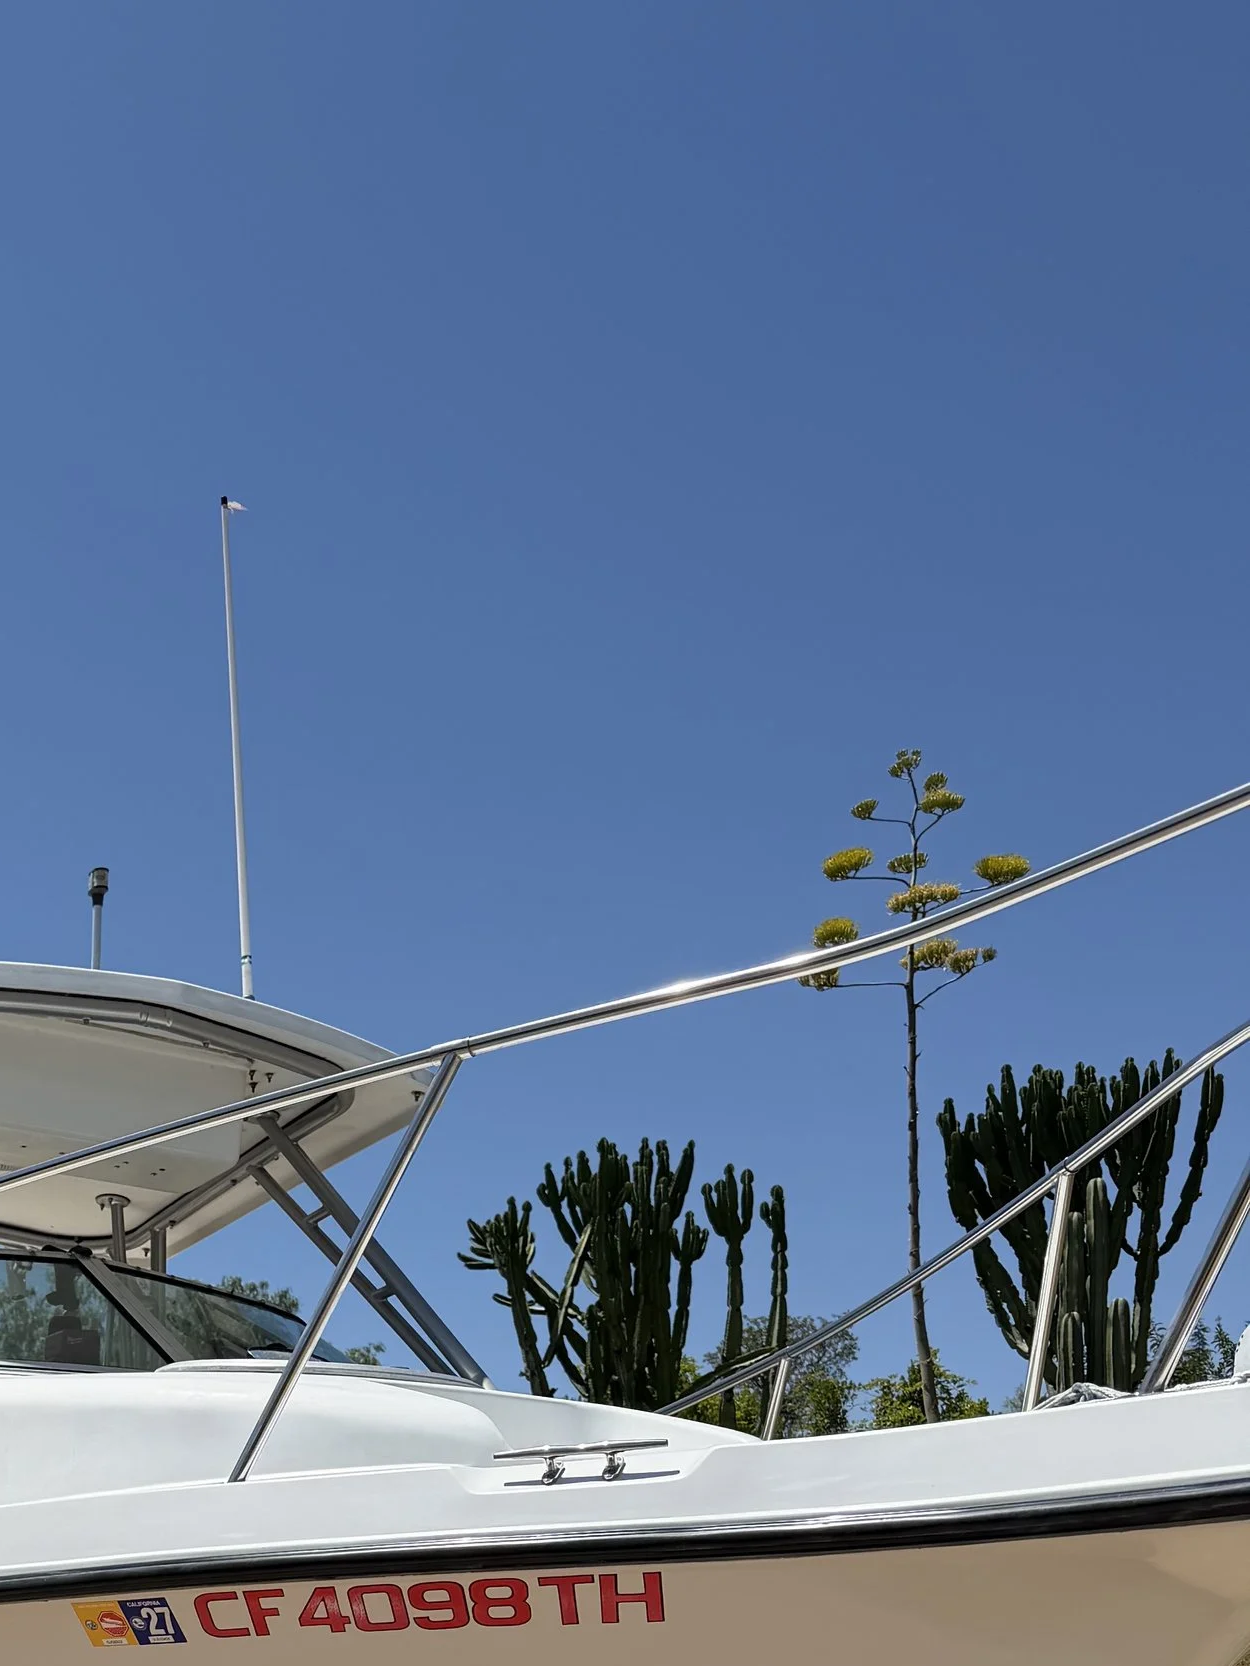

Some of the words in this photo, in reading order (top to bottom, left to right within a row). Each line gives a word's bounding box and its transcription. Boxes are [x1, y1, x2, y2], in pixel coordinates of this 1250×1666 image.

[141, 1607, 175, 1635] 27
[193, 1588, 285, 1638] CF
[298, 1577, 532, 1632] 4098
[537, 1571, 665, 1625] TH
